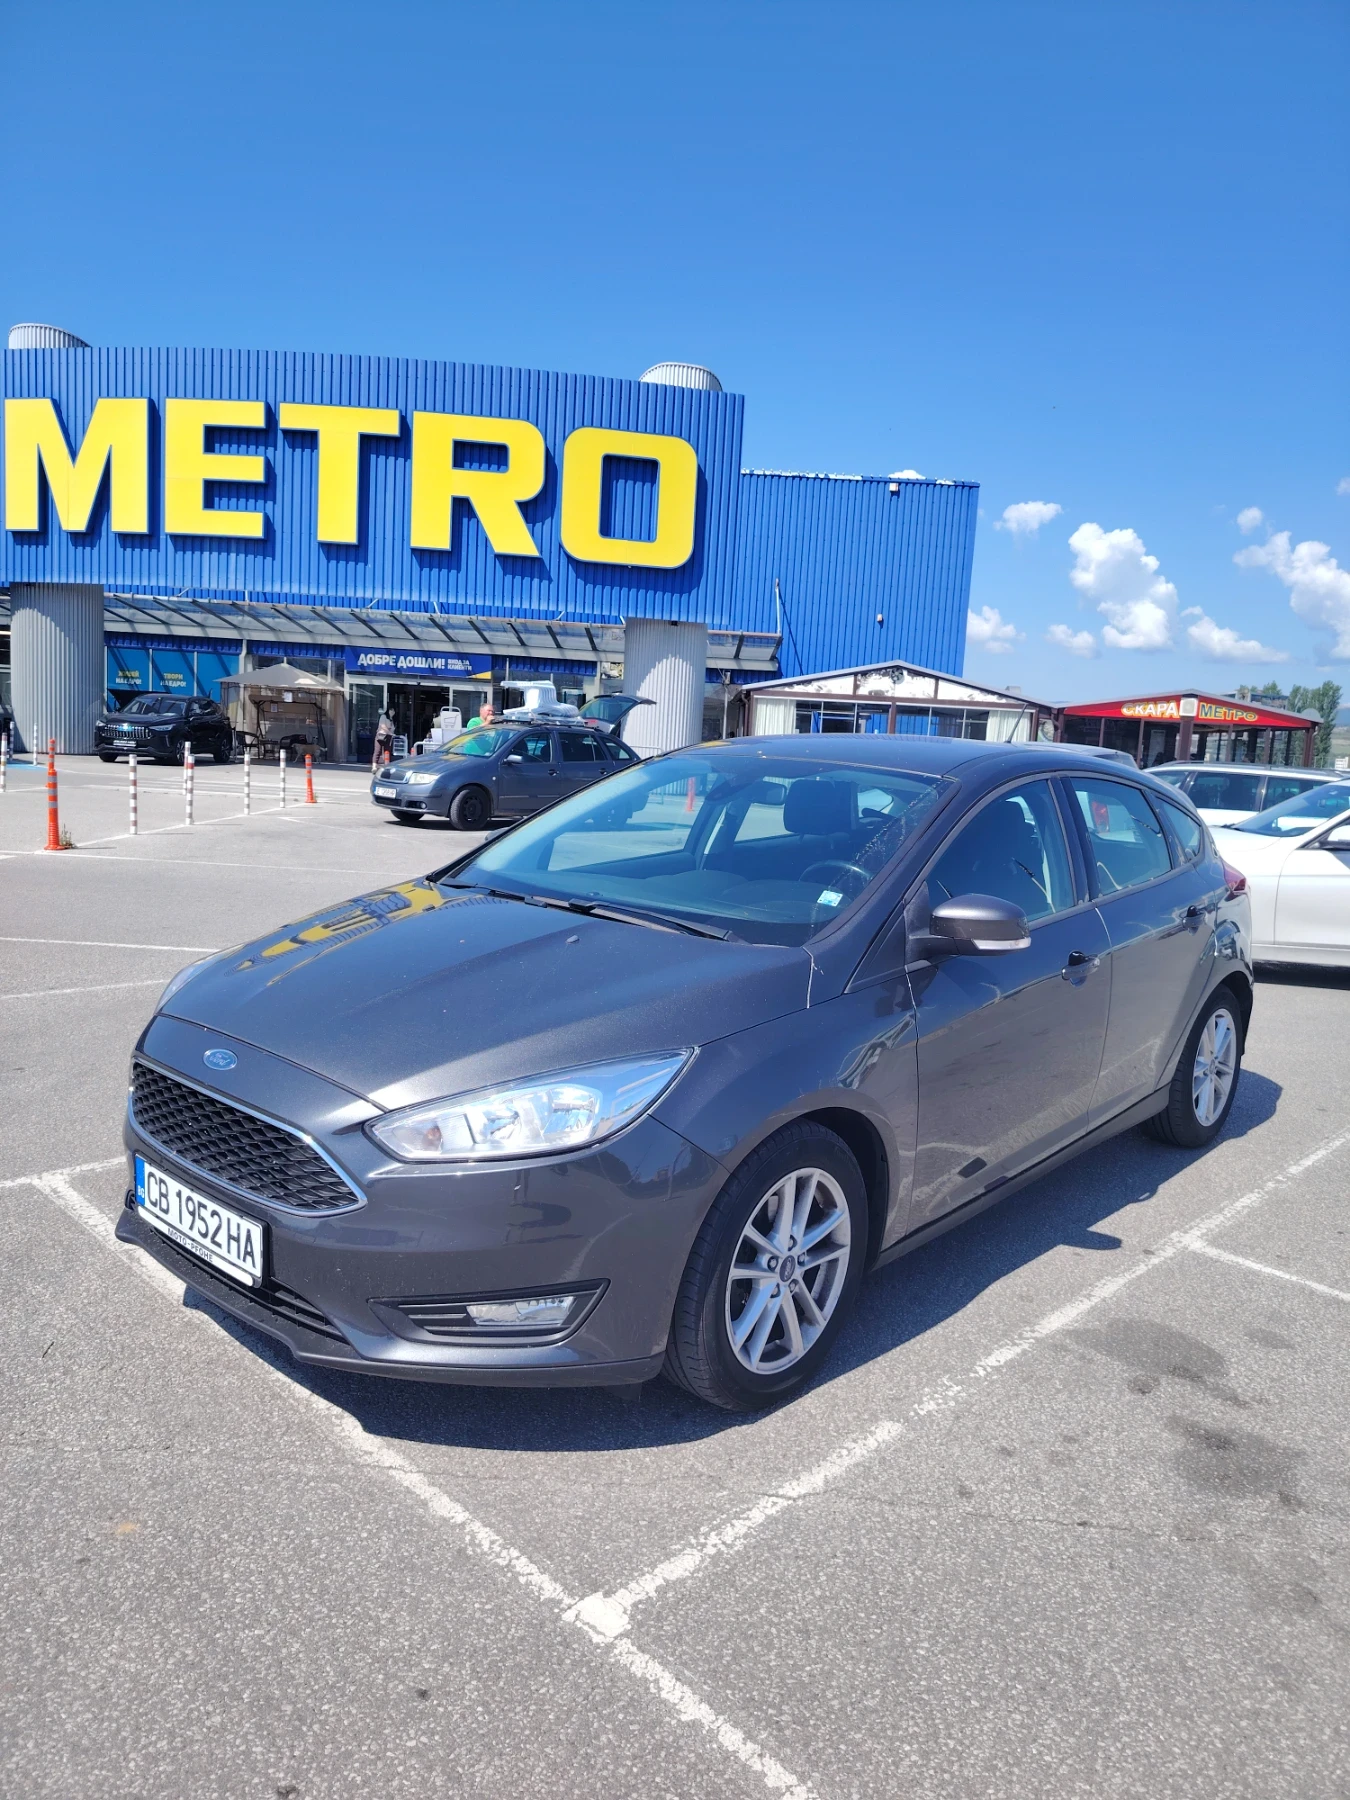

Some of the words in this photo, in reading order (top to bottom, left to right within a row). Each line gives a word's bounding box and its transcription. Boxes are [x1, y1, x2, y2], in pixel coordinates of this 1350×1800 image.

[4, 397, 699, 569] METRO
[357, 653, 397, 666] ДОБРЕ
[397, 656, 446, 669] ДОШЛИ!
[1121, 700, 1179, 717] СКАРА
[1199, 703, 1258, 721] МЕТРО
[137, 1185, 145, 1199] BG
[147, 1171, 170, 1215] CB
[175, 1189, 222, 1249] 1952
[227, 1217, 257, 1269] HA
